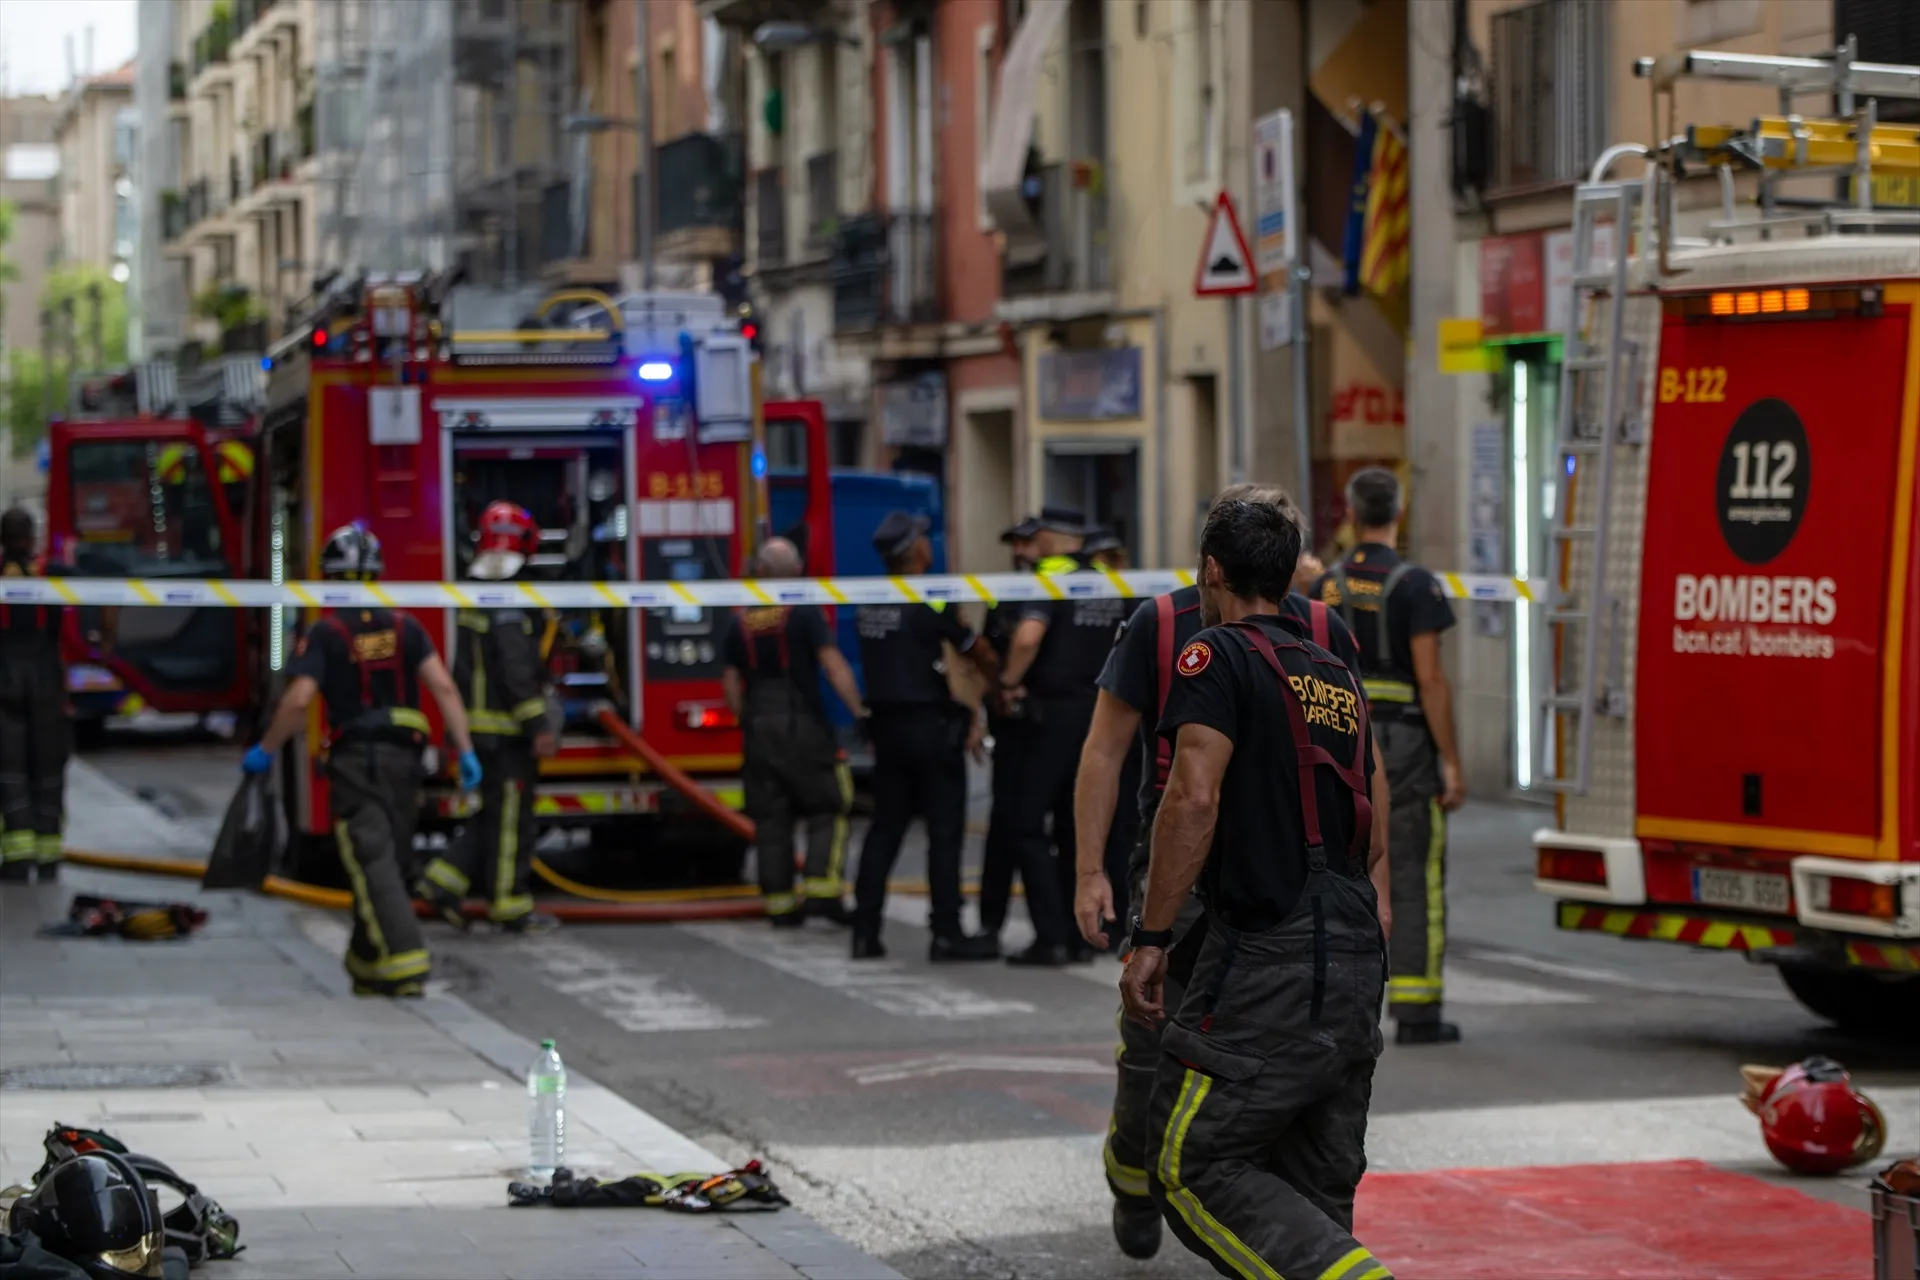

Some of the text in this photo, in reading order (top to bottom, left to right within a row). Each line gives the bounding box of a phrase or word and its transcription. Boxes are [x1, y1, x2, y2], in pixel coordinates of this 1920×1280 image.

[1660, 367, 1727, 402] B-122
[1729, 441, 1797, 499] 112
[1674, 574, 1837, 625] BOMBERS
[1673, 624, 1834, 659] bcn.cat/bombers
[1288, 675, 1359, 718] BOMBER
[1303, 704, 1359, 736] ARCELON
